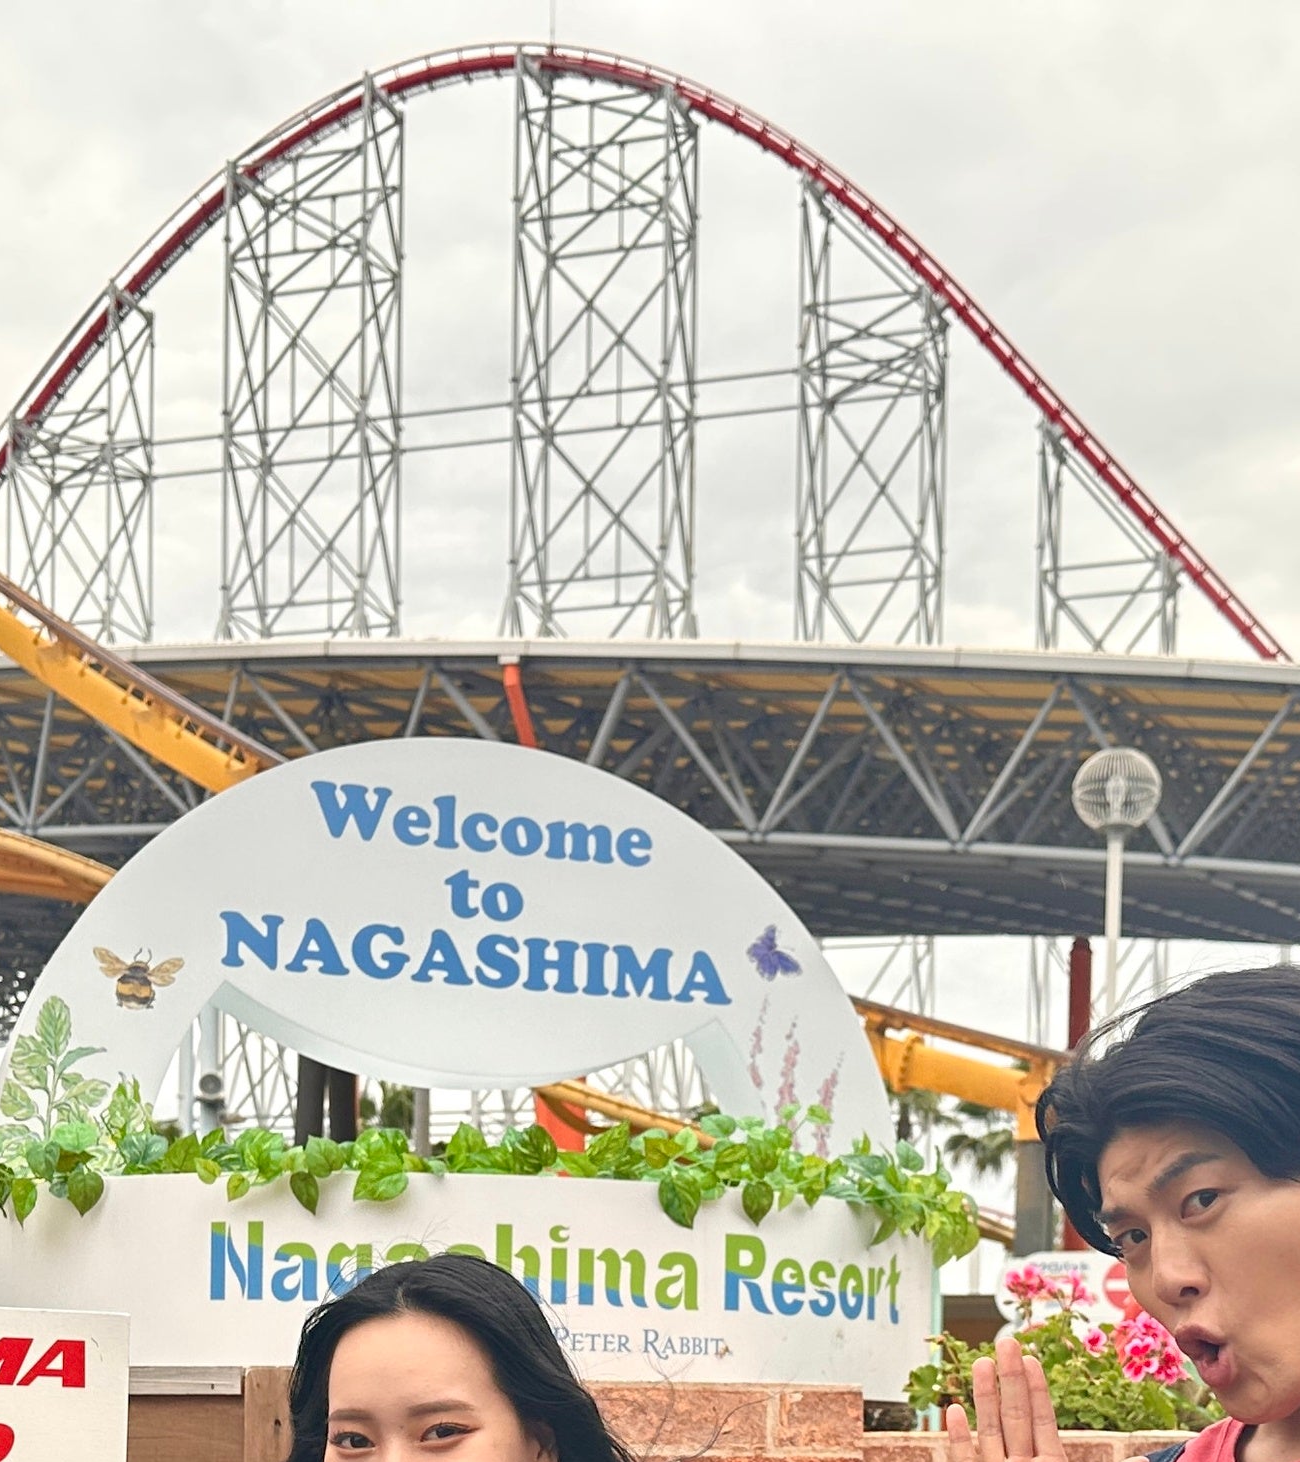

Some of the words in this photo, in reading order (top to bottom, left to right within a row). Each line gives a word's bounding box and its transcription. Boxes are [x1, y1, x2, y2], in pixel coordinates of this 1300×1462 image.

[311, 780, 653, 868] Welcome
[444, 869, 525, 923] to
[219, 910, 733, 1006] NAGASHIMA
[209, 1220, 699, 1311] Naghima
[723, 1233, 901, 1324] Resort
[643, 1329, 724, 1360] RABBIT
